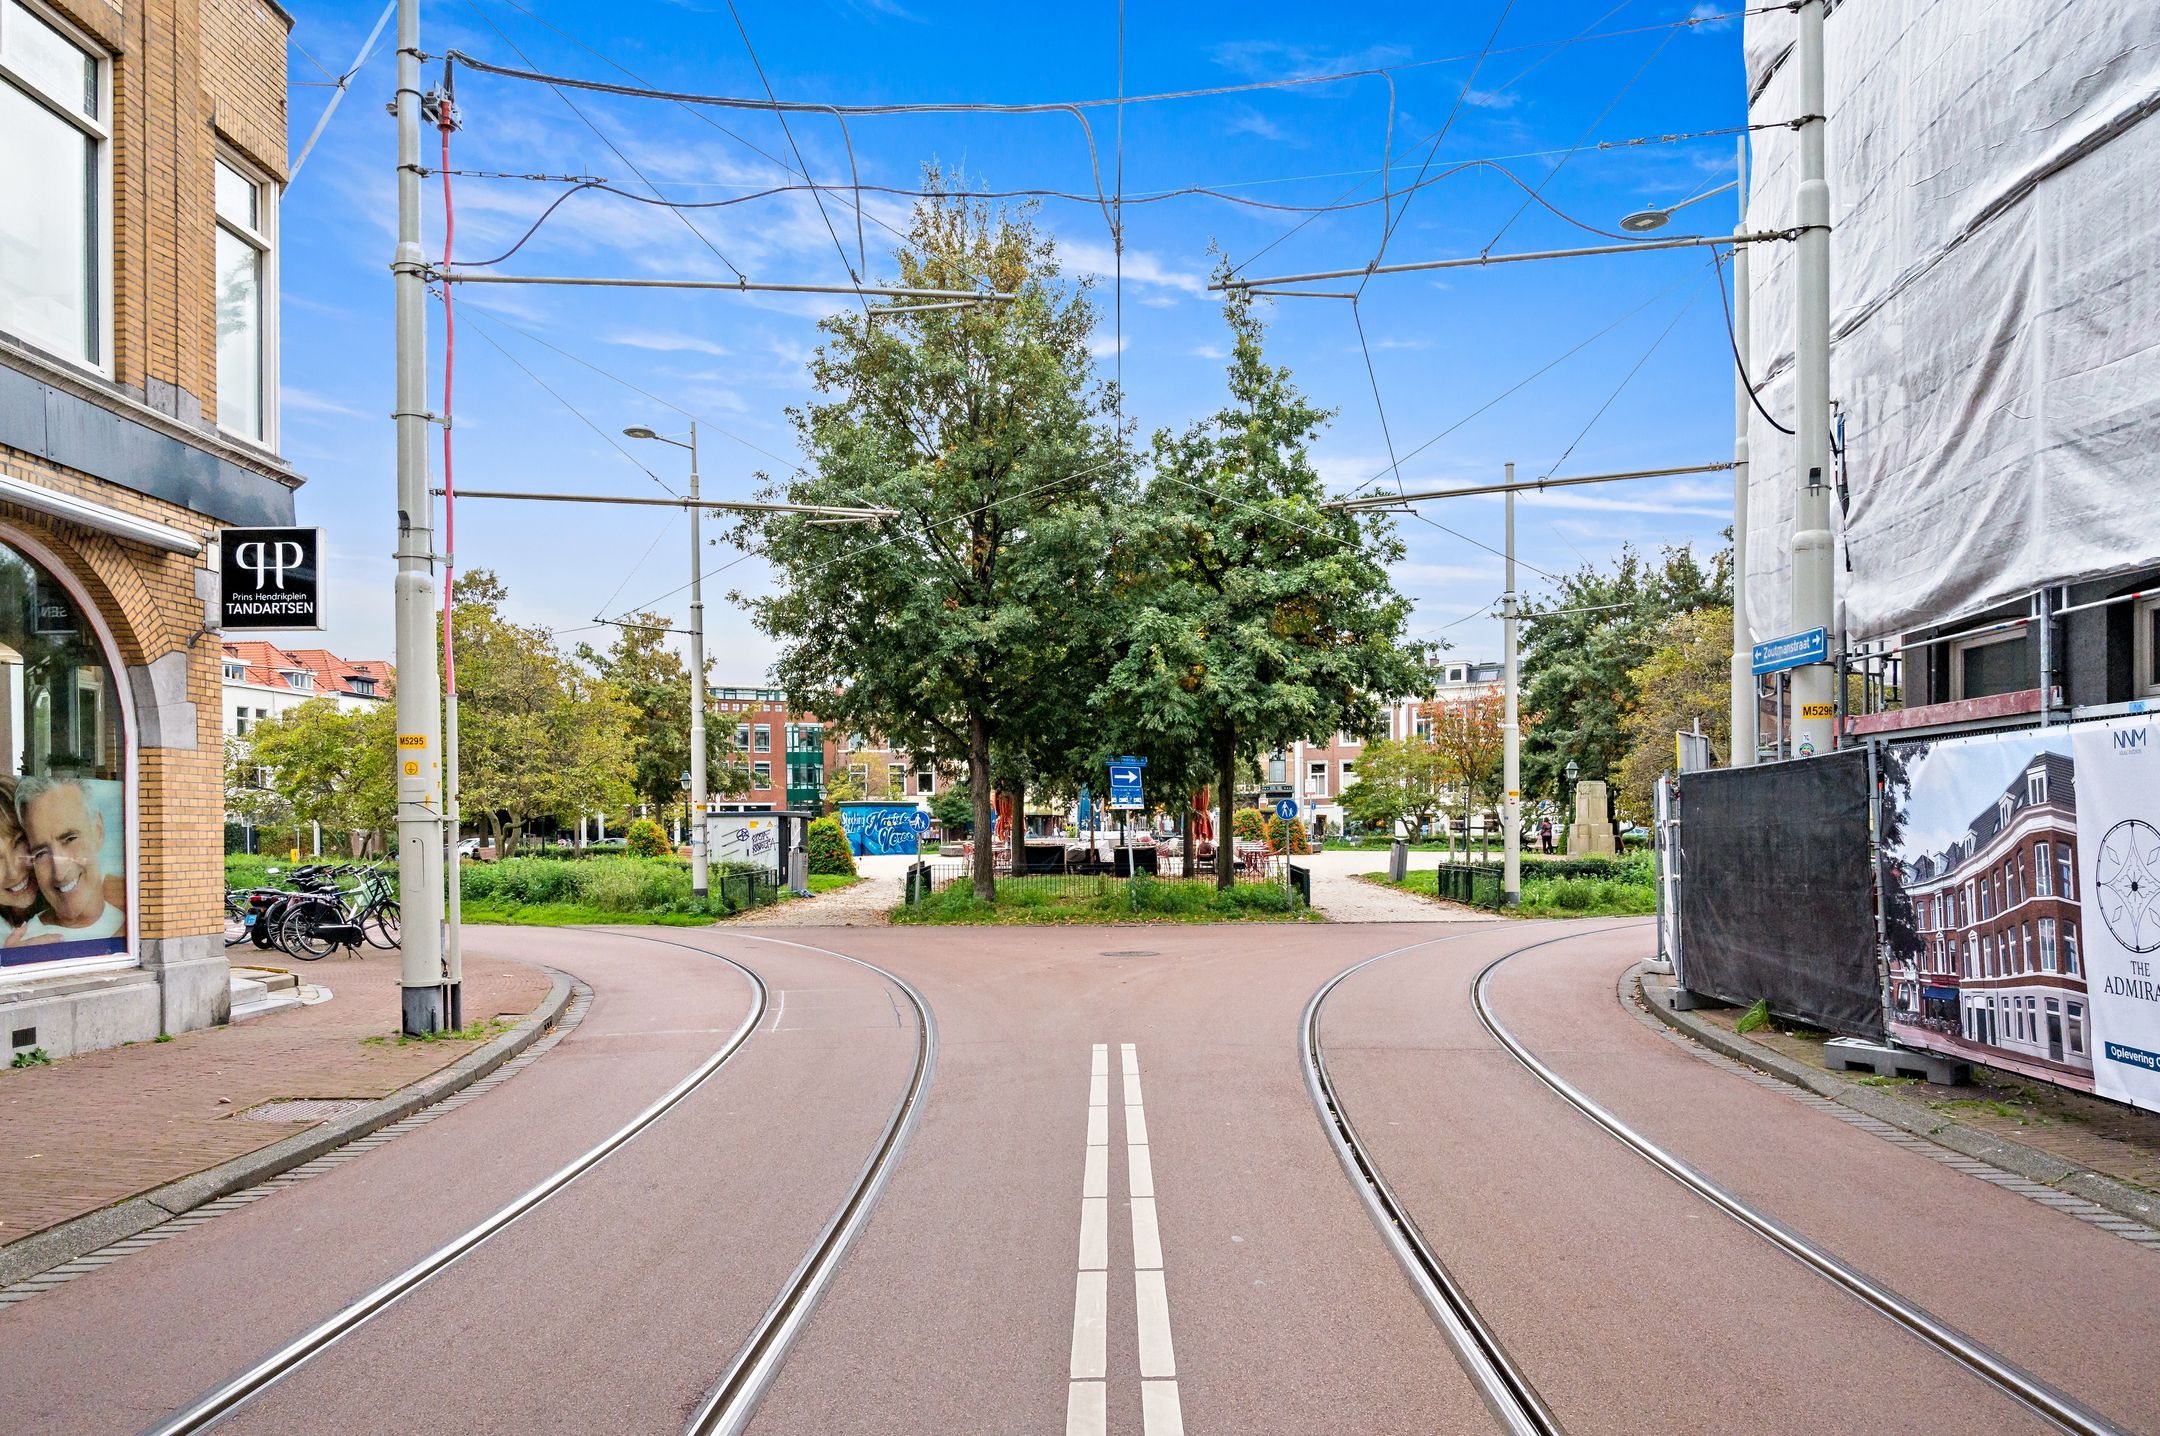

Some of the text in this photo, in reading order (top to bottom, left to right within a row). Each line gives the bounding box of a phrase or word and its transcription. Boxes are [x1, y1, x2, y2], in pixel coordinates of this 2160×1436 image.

[232, 592, 307, 602] Prins Hendrikplein
[226, 602, 314, 615] TANDARTSEN
[1763, 636, 1811, 659] Zoutmanstraat
[1802, 705, 1833, 717] M5296
[400, 736, 424, 746] M5295
[2130, 960, 2151, 977] THE
[2110, 1045, 2155, 1068] Oplevering
